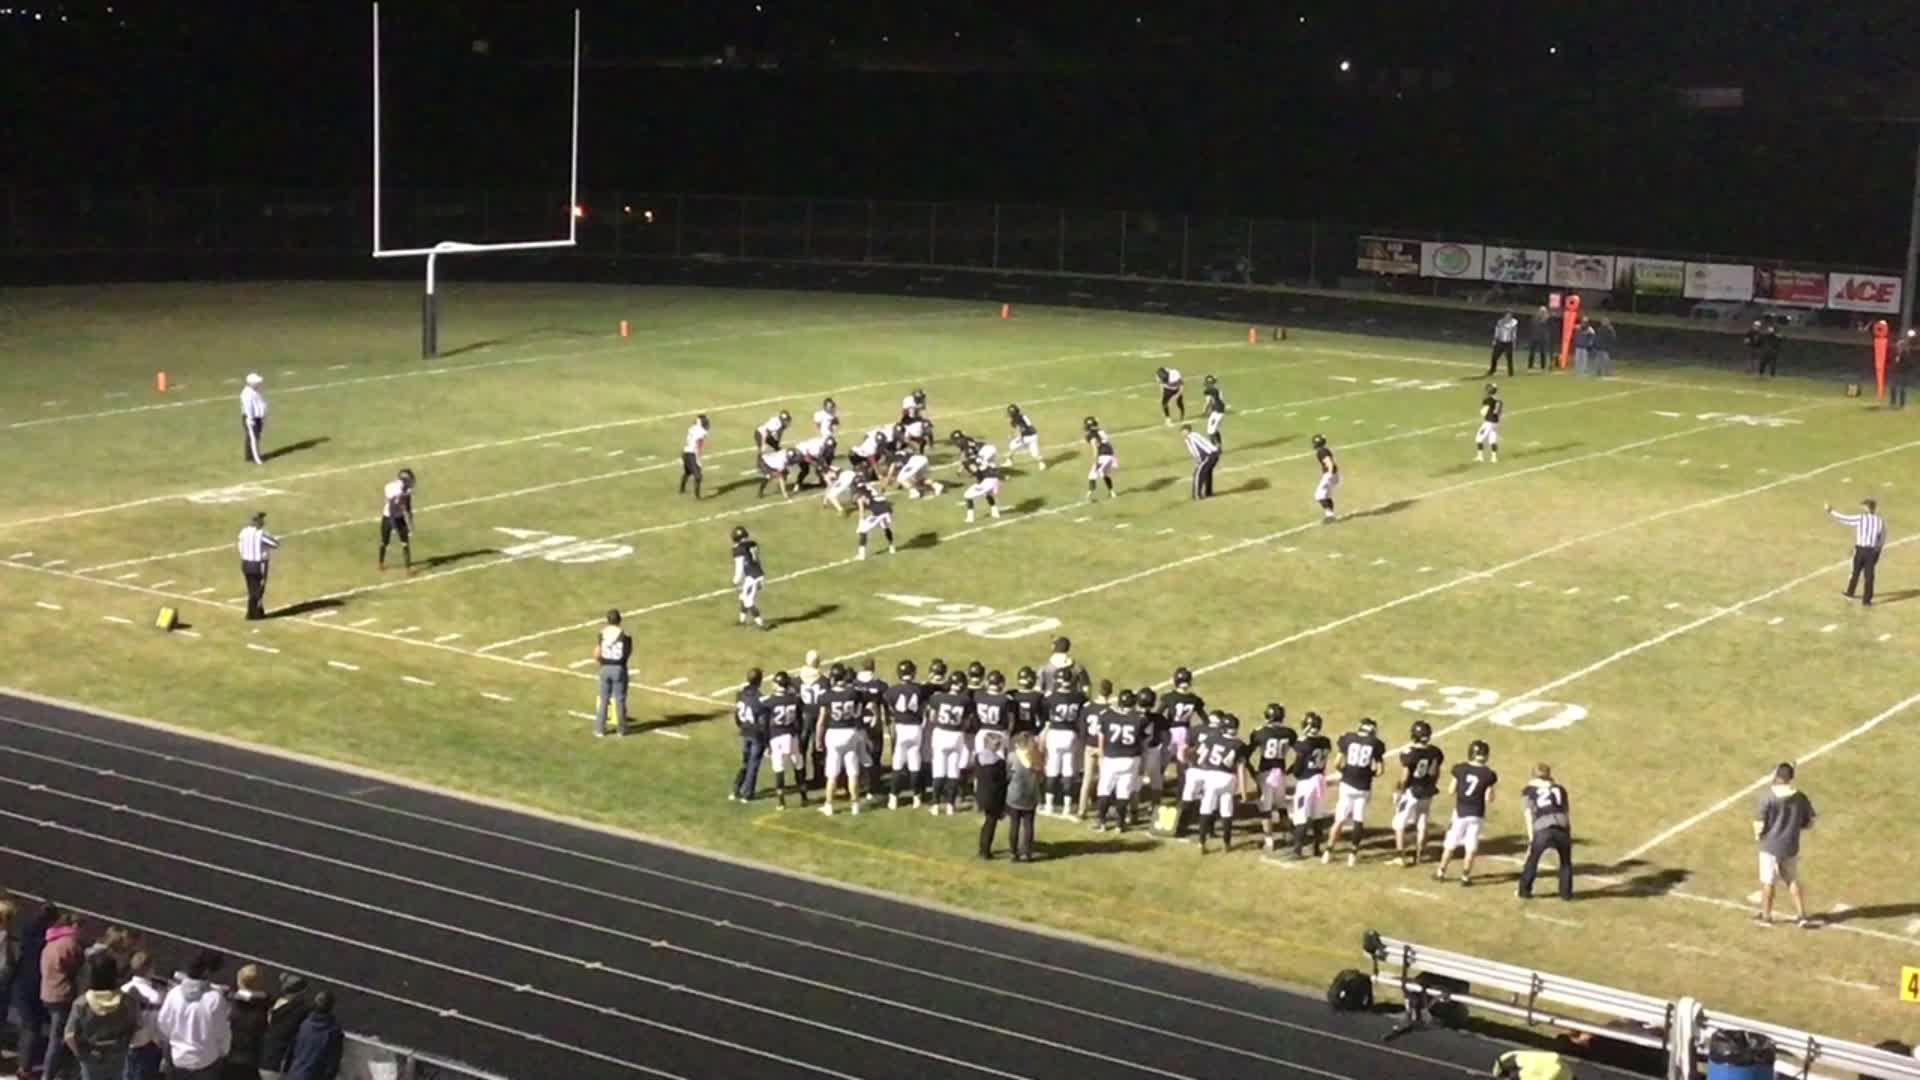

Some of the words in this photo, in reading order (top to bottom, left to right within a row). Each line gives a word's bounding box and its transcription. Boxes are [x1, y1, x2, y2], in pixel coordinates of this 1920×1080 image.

[1834, 278, 1896, 303] ACE
[503, 535, 635, 563] 10
[891, 603, 1062, 639] 20
[894, 693, 918, 712] 44
[1401, 686, 1588, 731] 30
[938, 704, 963, 726] 53
[1109, 724, 1134, 745] 75
[1347, 742, 1373, 767] 88
[1465, 774, 1479, 796] 7
[1536, 784, 1563, 806] 21
